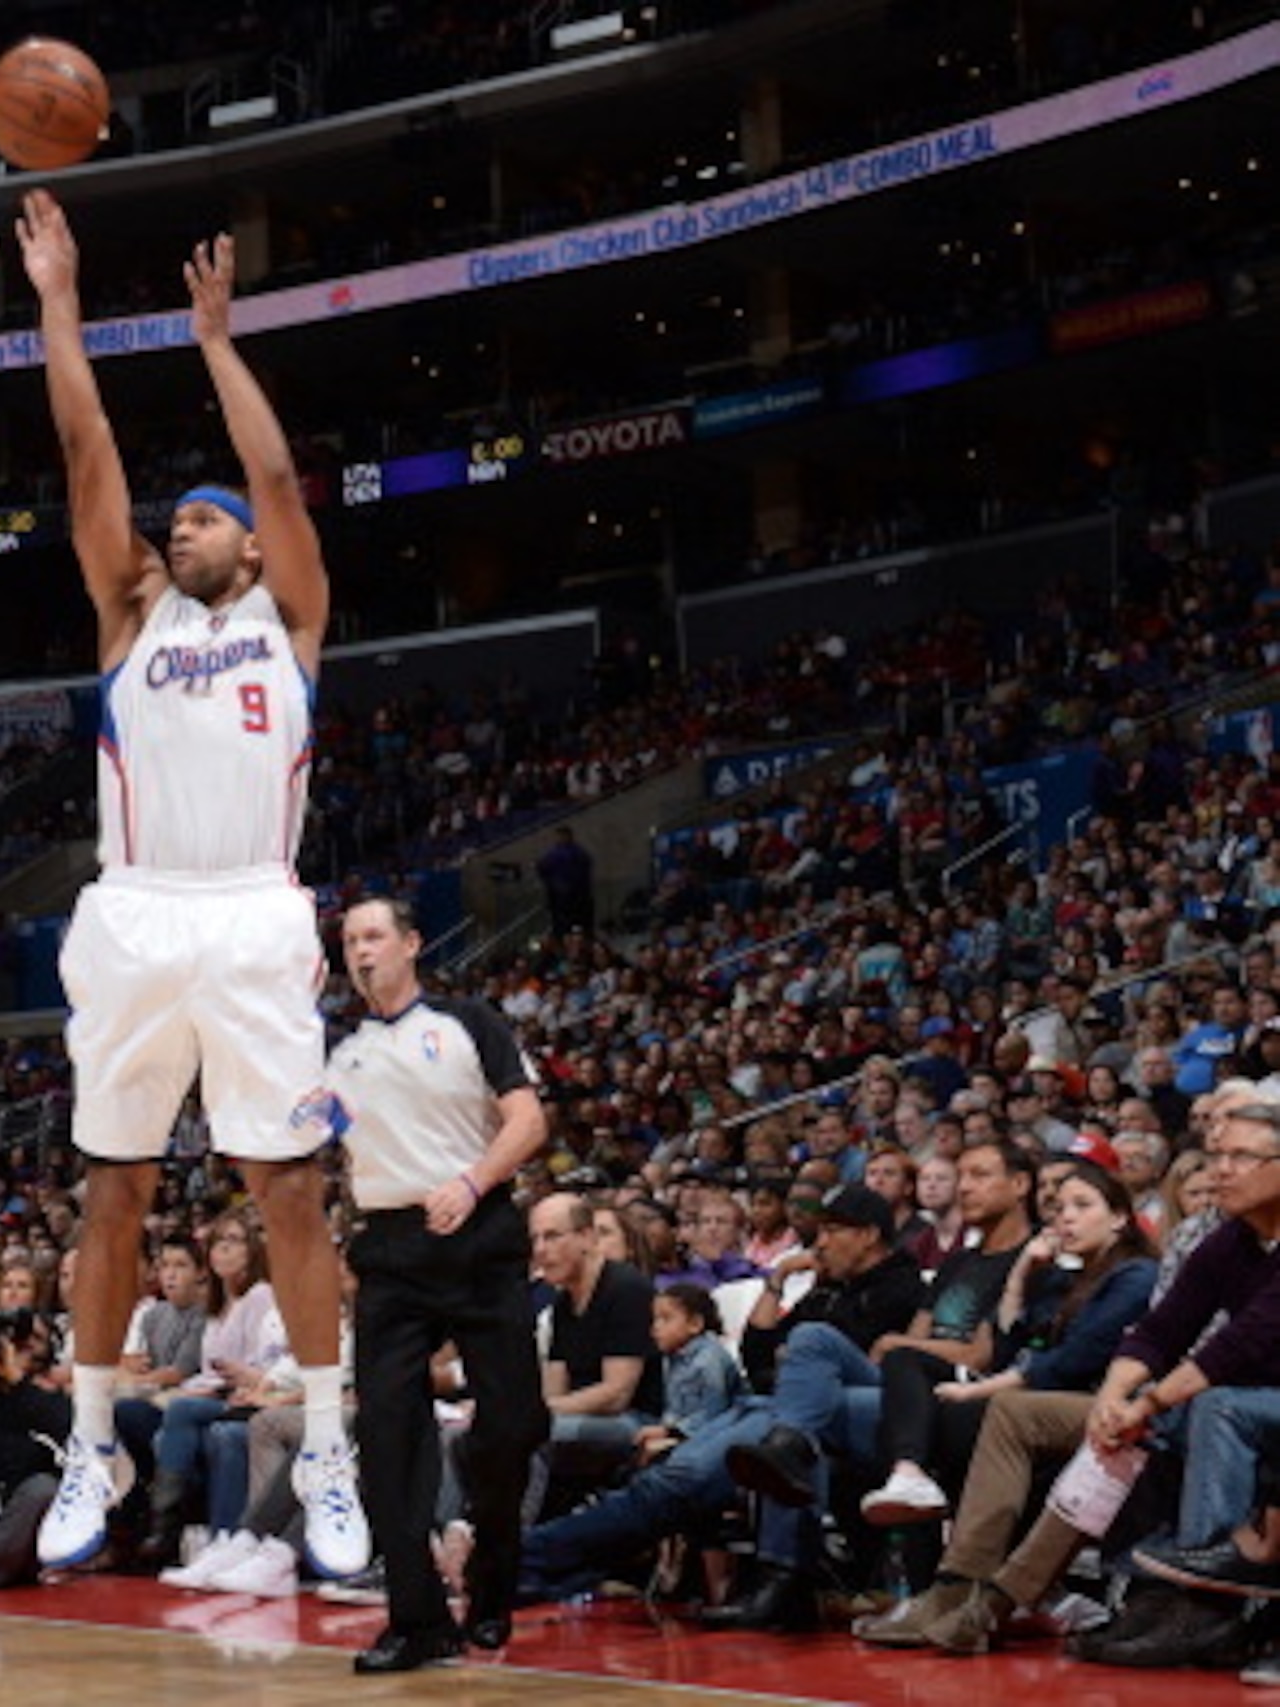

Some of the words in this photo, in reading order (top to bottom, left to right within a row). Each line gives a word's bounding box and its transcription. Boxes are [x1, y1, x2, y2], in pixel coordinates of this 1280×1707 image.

[936, 121, 997, 166] MEAL
[542, 411, 686, 463] TOYOTA
[147, 637, 273, 694] Clippers
[239, 681, 271, 732] 9
